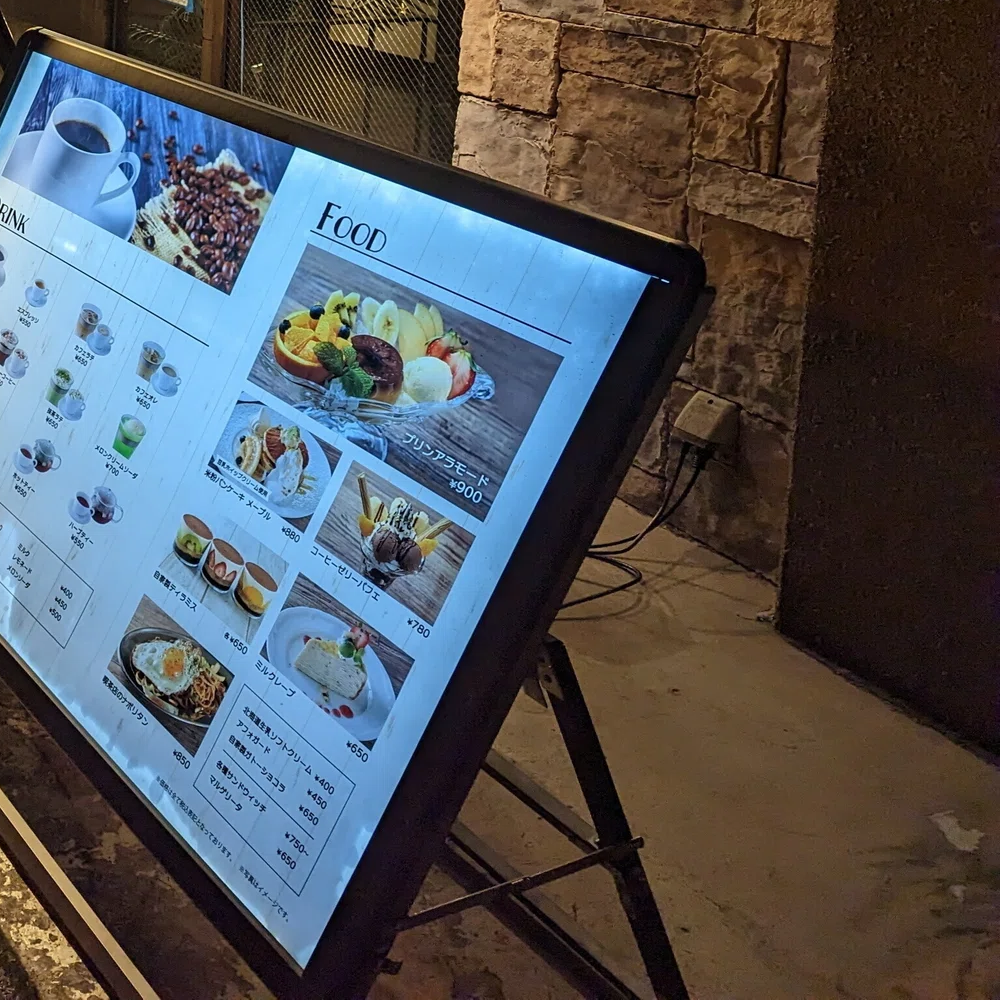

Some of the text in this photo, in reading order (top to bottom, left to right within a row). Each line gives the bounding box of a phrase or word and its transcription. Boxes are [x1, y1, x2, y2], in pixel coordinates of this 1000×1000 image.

[316, 201, 387, 253] FOOD
[73, 344, 95, 361] カフェラテ
[74, 353, 88, 367] ¥650
[135, 386, 158, 404] カフェオレ
[135, 395, 151, 410] ¥650
[45, 415, 59, 430] ¥650
[12, 472, 36, 493] ホットティー
[94, 444, 139, 480] メロンクリームソーダ
[105, 461, 120, 477] ¥700
[402, 432, 489, 487] プリンアラモード
[14, 483, 28, 498] ¥550
[203, 468, 301, 543] 米粉パンケーキ メープル ¥880
[449, 478, 483, 503] ¥900
[68, 521, 94, 545] ハーブティー
[70, 533, 85, 550] ¥550
[6, 565, 62, 622] メロンソーダ ¥500
[12, 553, 68, 611] レモネード ¥450
[17, 543, 73, 600] ミルク ¥400
[153, 570, 198, 613] 自家製ティラミス
[310, 545, 431, 639] コーヒーゼリーパフェ ¥780
[102, 675, 191, 770] 喫茶店のナポリタン ¥850
[254, 659, 369, 763] ミルクレープ ¥650
[236, 719, 328, 810] アフォガード ¥450
[242, 706, 335, 795] 北海道生乳ソフトクリーム ¥400
[215, 760, 267, 813] 各種サンドウィッチ
[228, 734, 319, 826] 自家製ガトーショコラ ¥650
[209, 774, 297, 870] マルゲリータ ¥650
